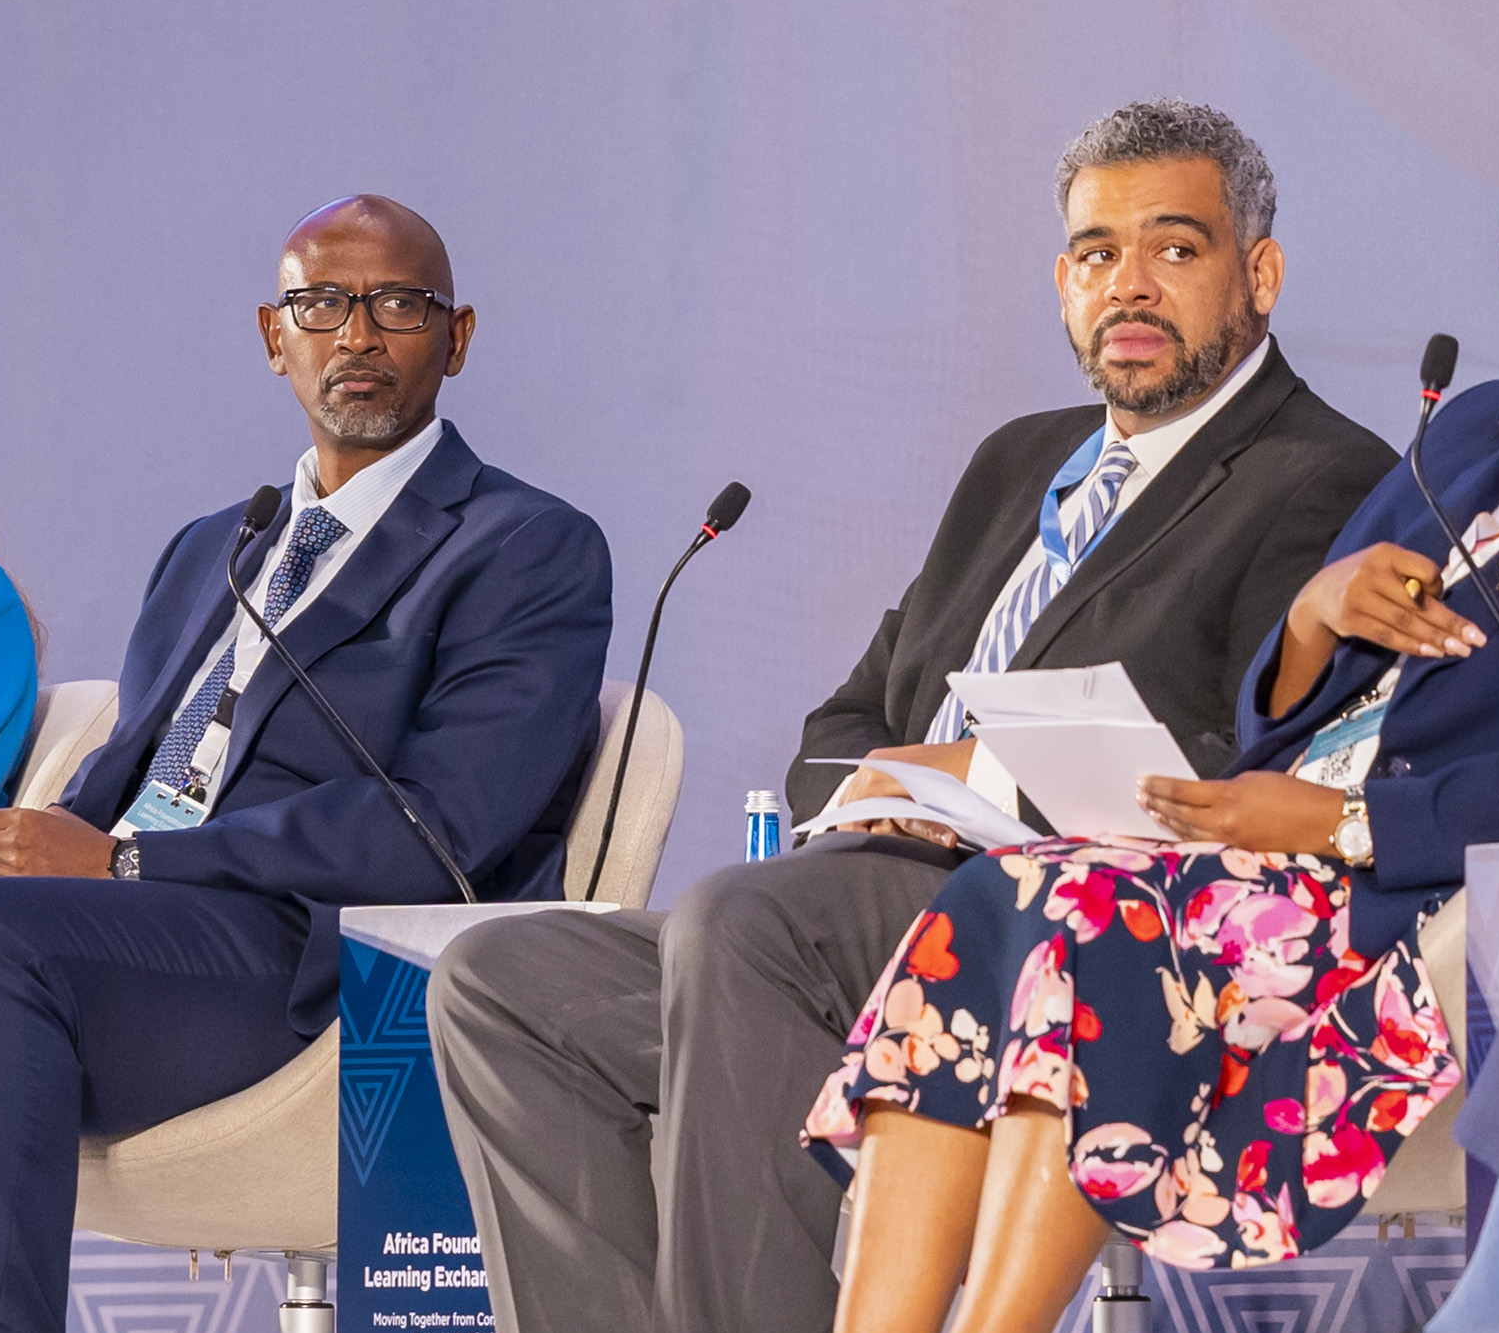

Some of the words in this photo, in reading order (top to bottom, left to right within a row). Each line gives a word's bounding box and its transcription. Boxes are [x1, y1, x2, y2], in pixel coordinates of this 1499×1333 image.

[383, 1232, 429, 1255] Africa
[432, 1232, 481, 1255] Found
[364, 1265, 431, 1292] Learning
[434, 1265, 489, 1288] Exchan
[373, 1312, 407, 1329] Moving
[409, 1312, 451, 1329] Together
[452, 1312, 475, 1326] from
